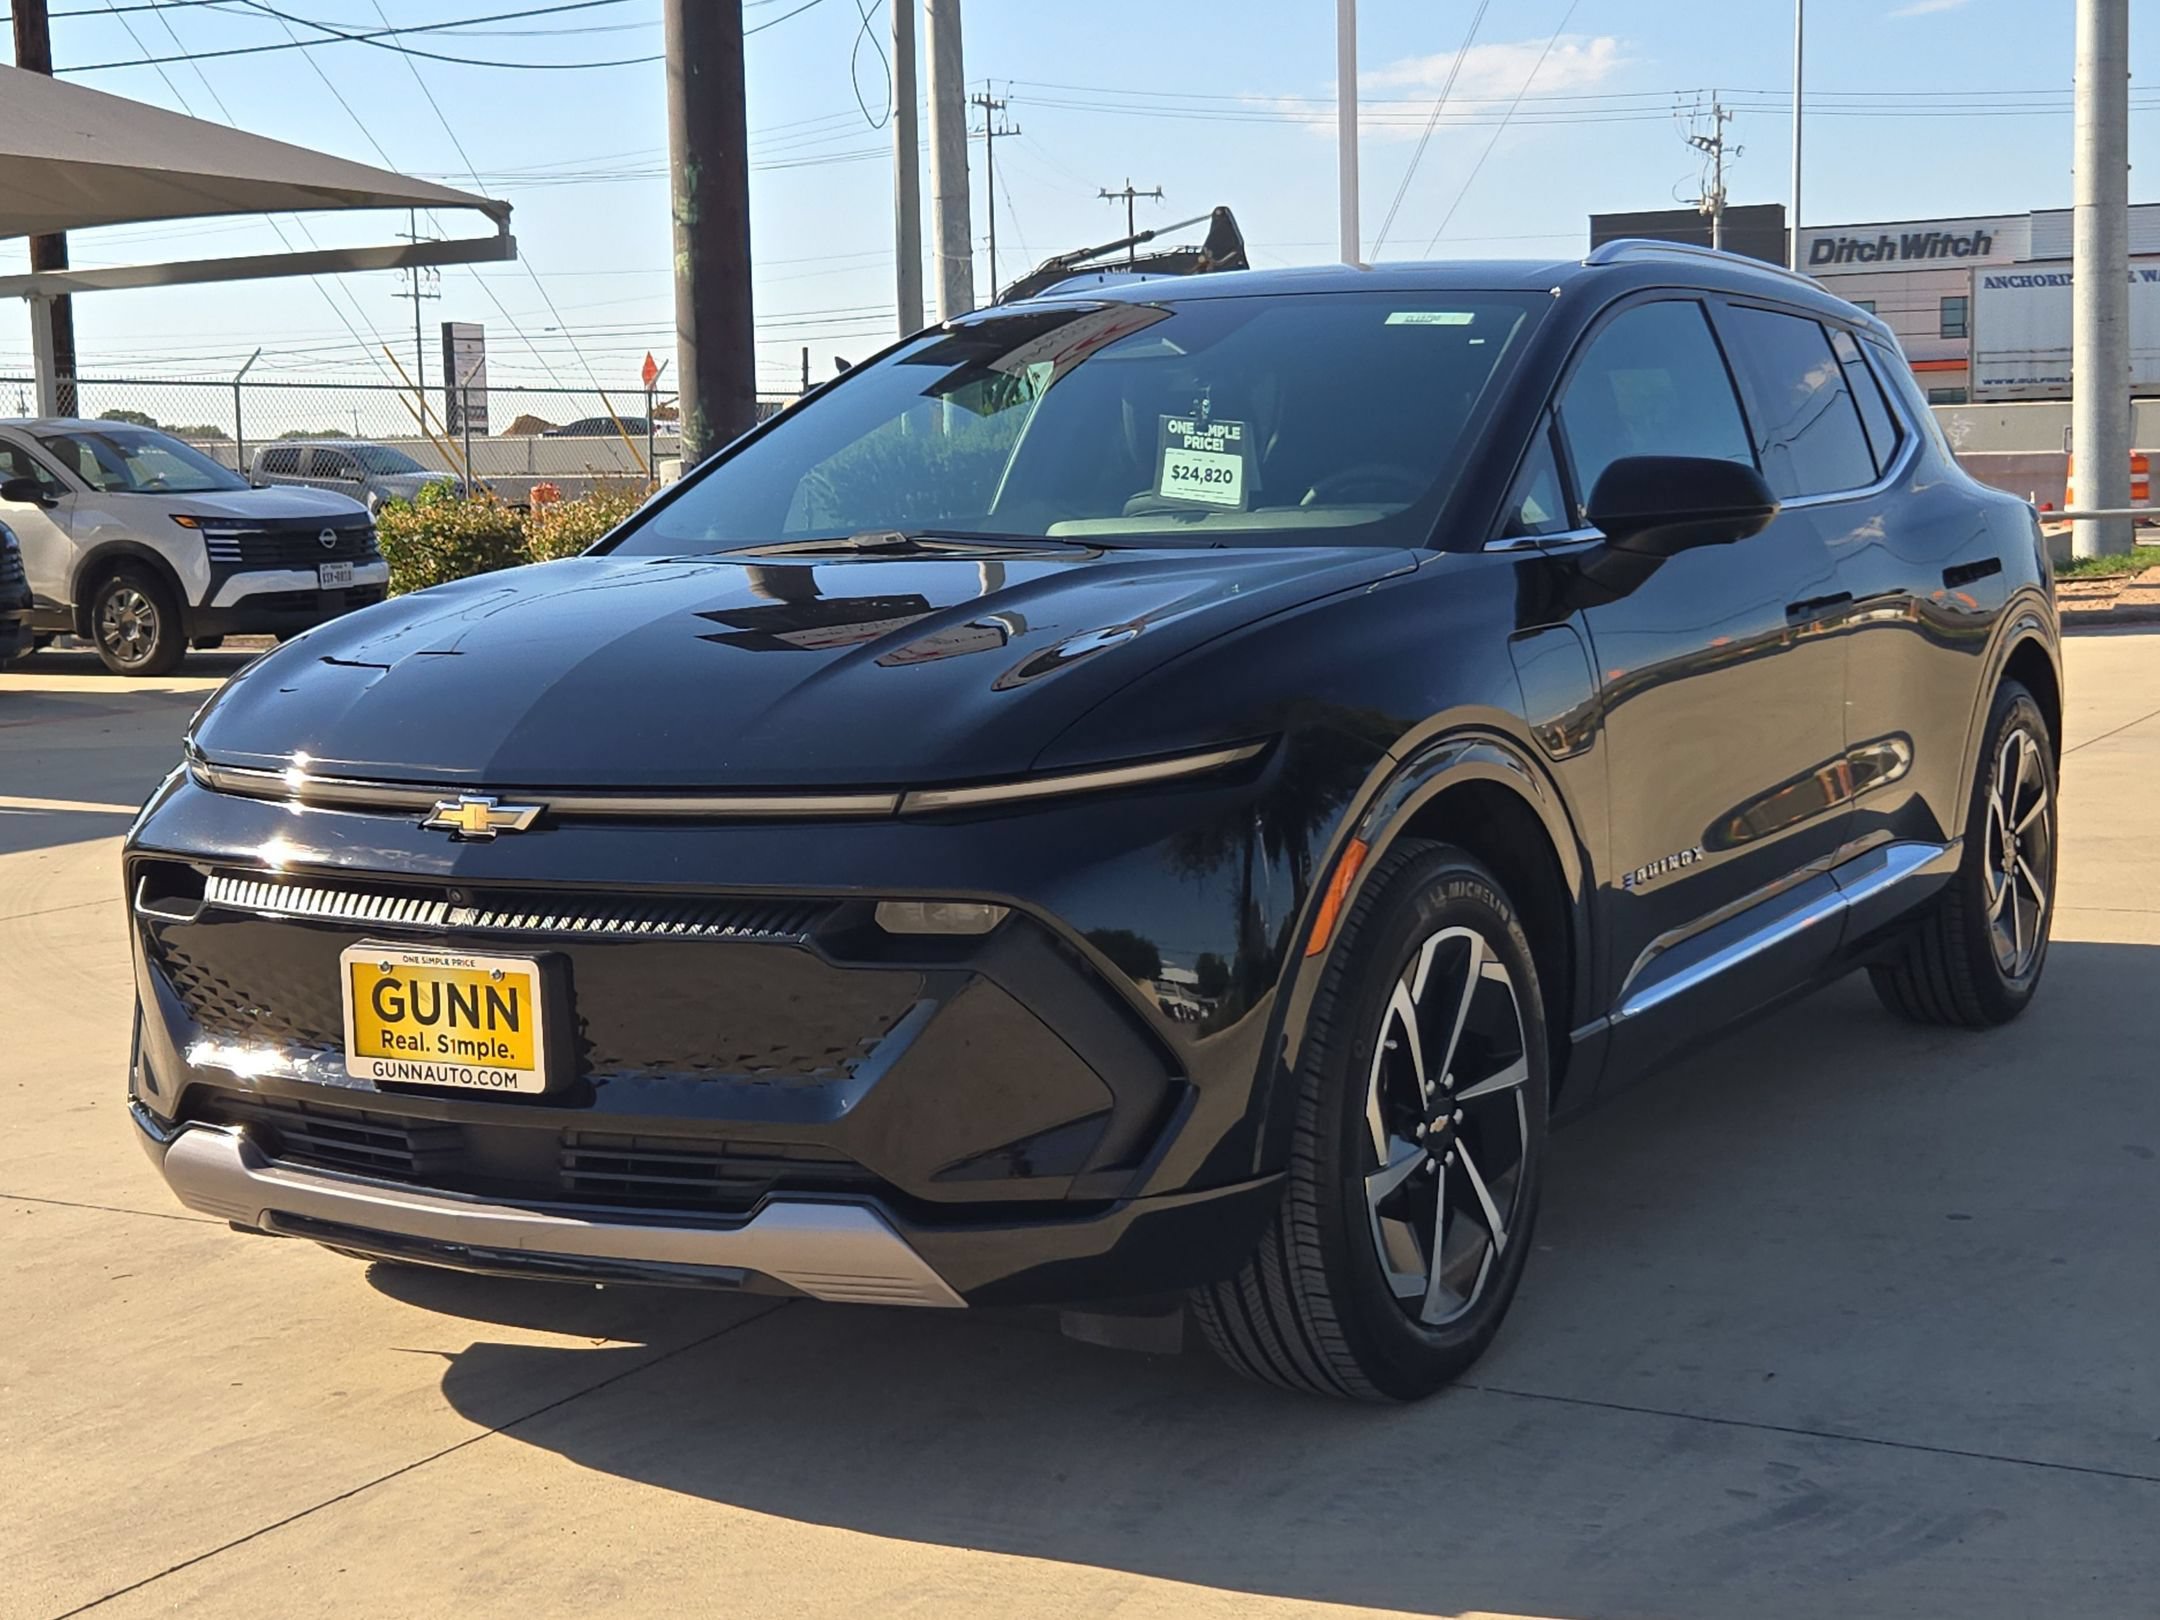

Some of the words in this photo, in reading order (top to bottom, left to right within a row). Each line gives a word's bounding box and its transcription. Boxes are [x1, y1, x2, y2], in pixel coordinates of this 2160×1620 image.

[1808, 235, 1896, 265] Ditch
[1900, 229, 1993, 260] Witch
[1168, 420, 1195, 434] ONE
[1196, 424, 1241, 440] MPLE
[1184, 435, 1224, 451] PRICE!
[1171, 464, 1234, 485] $24,820
[1622, 846, 1704, 892] EQUINOX
[402, 955, 420, 964] ONE
[421, 956, 449, 966] SIMPLE
[452, 958, 476, 967] PRICE
[371, 977, 520, 1033] GUNN
[381, 1030, 430, 1052] Real.
[372, 1061, 518, 1089] GUNNAUTO.COM
